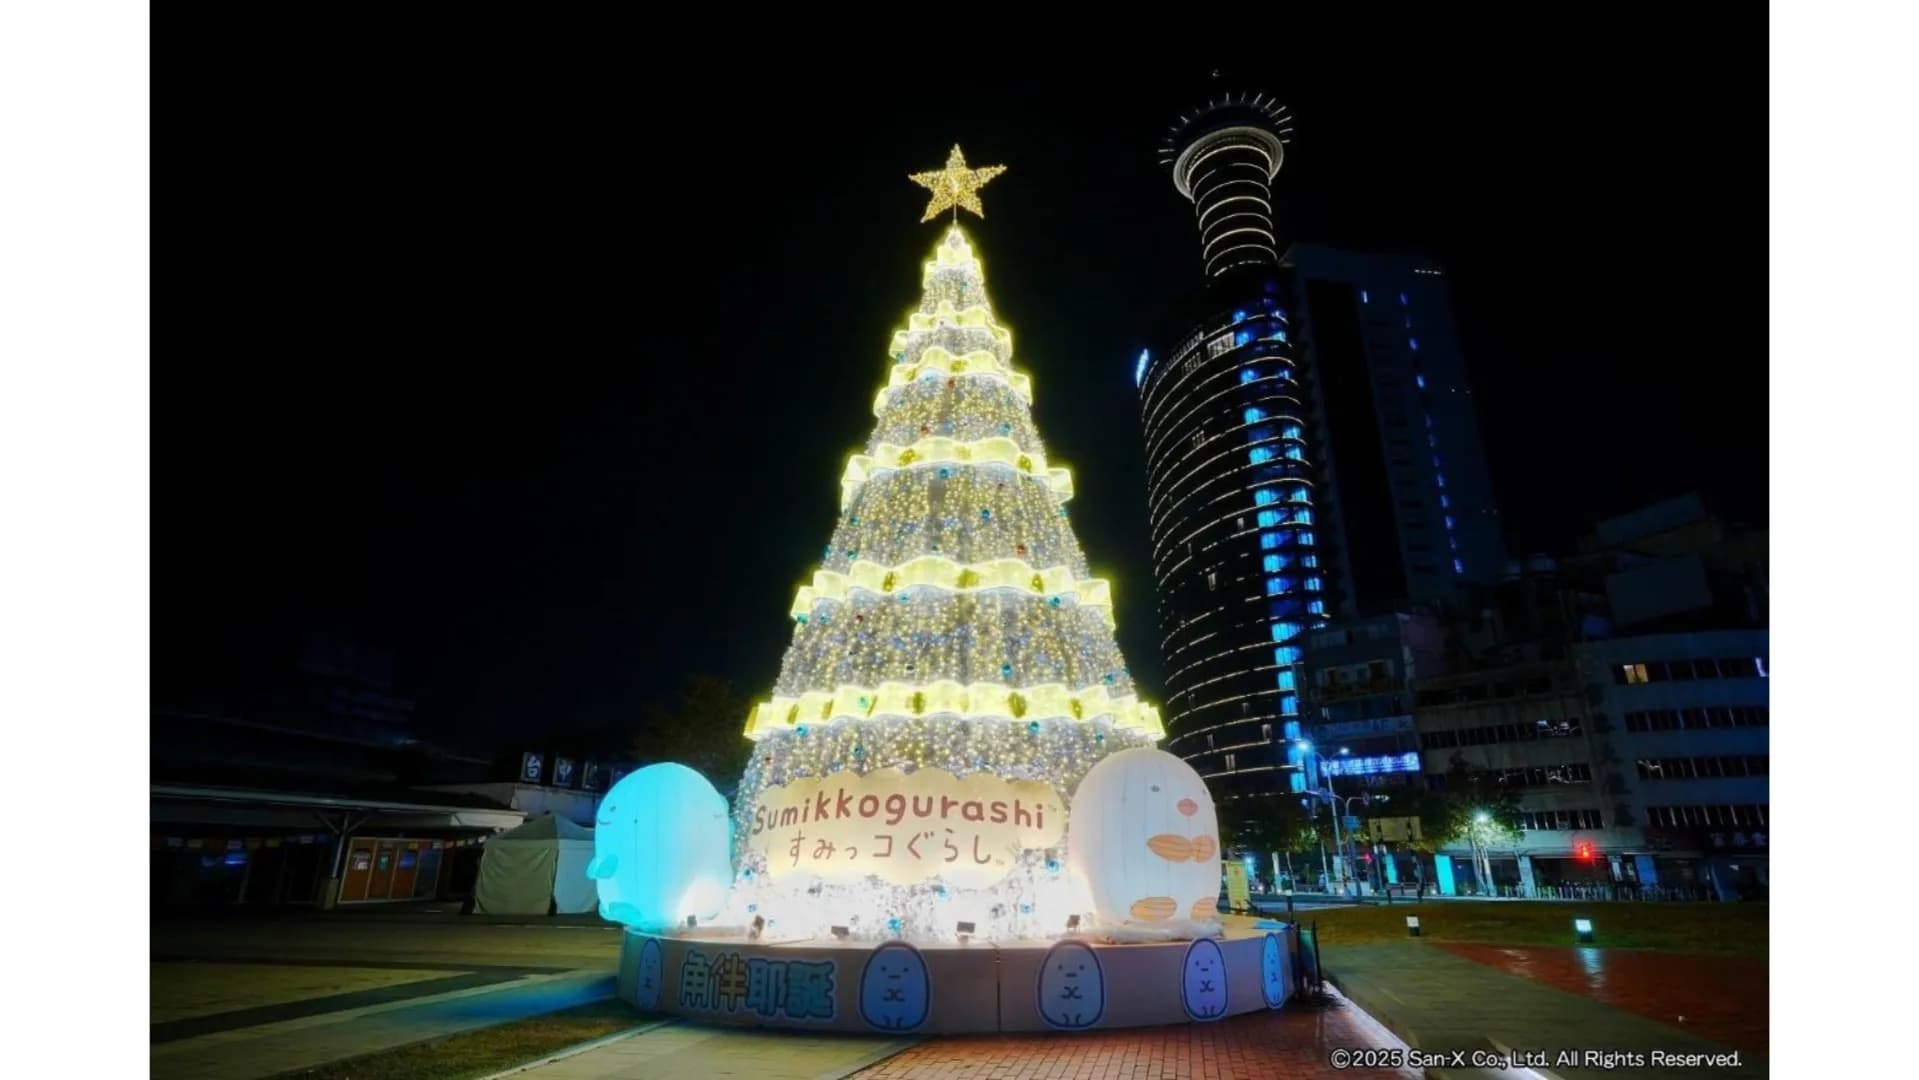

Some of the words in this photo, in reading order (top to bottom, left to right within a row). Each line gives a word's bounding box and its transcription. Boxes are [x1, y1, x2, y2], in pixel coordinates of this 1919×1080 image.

[752, 788, 1043, 835] Sumikkogurashi
[789, 828, 992, 867] すみっコぐらし
